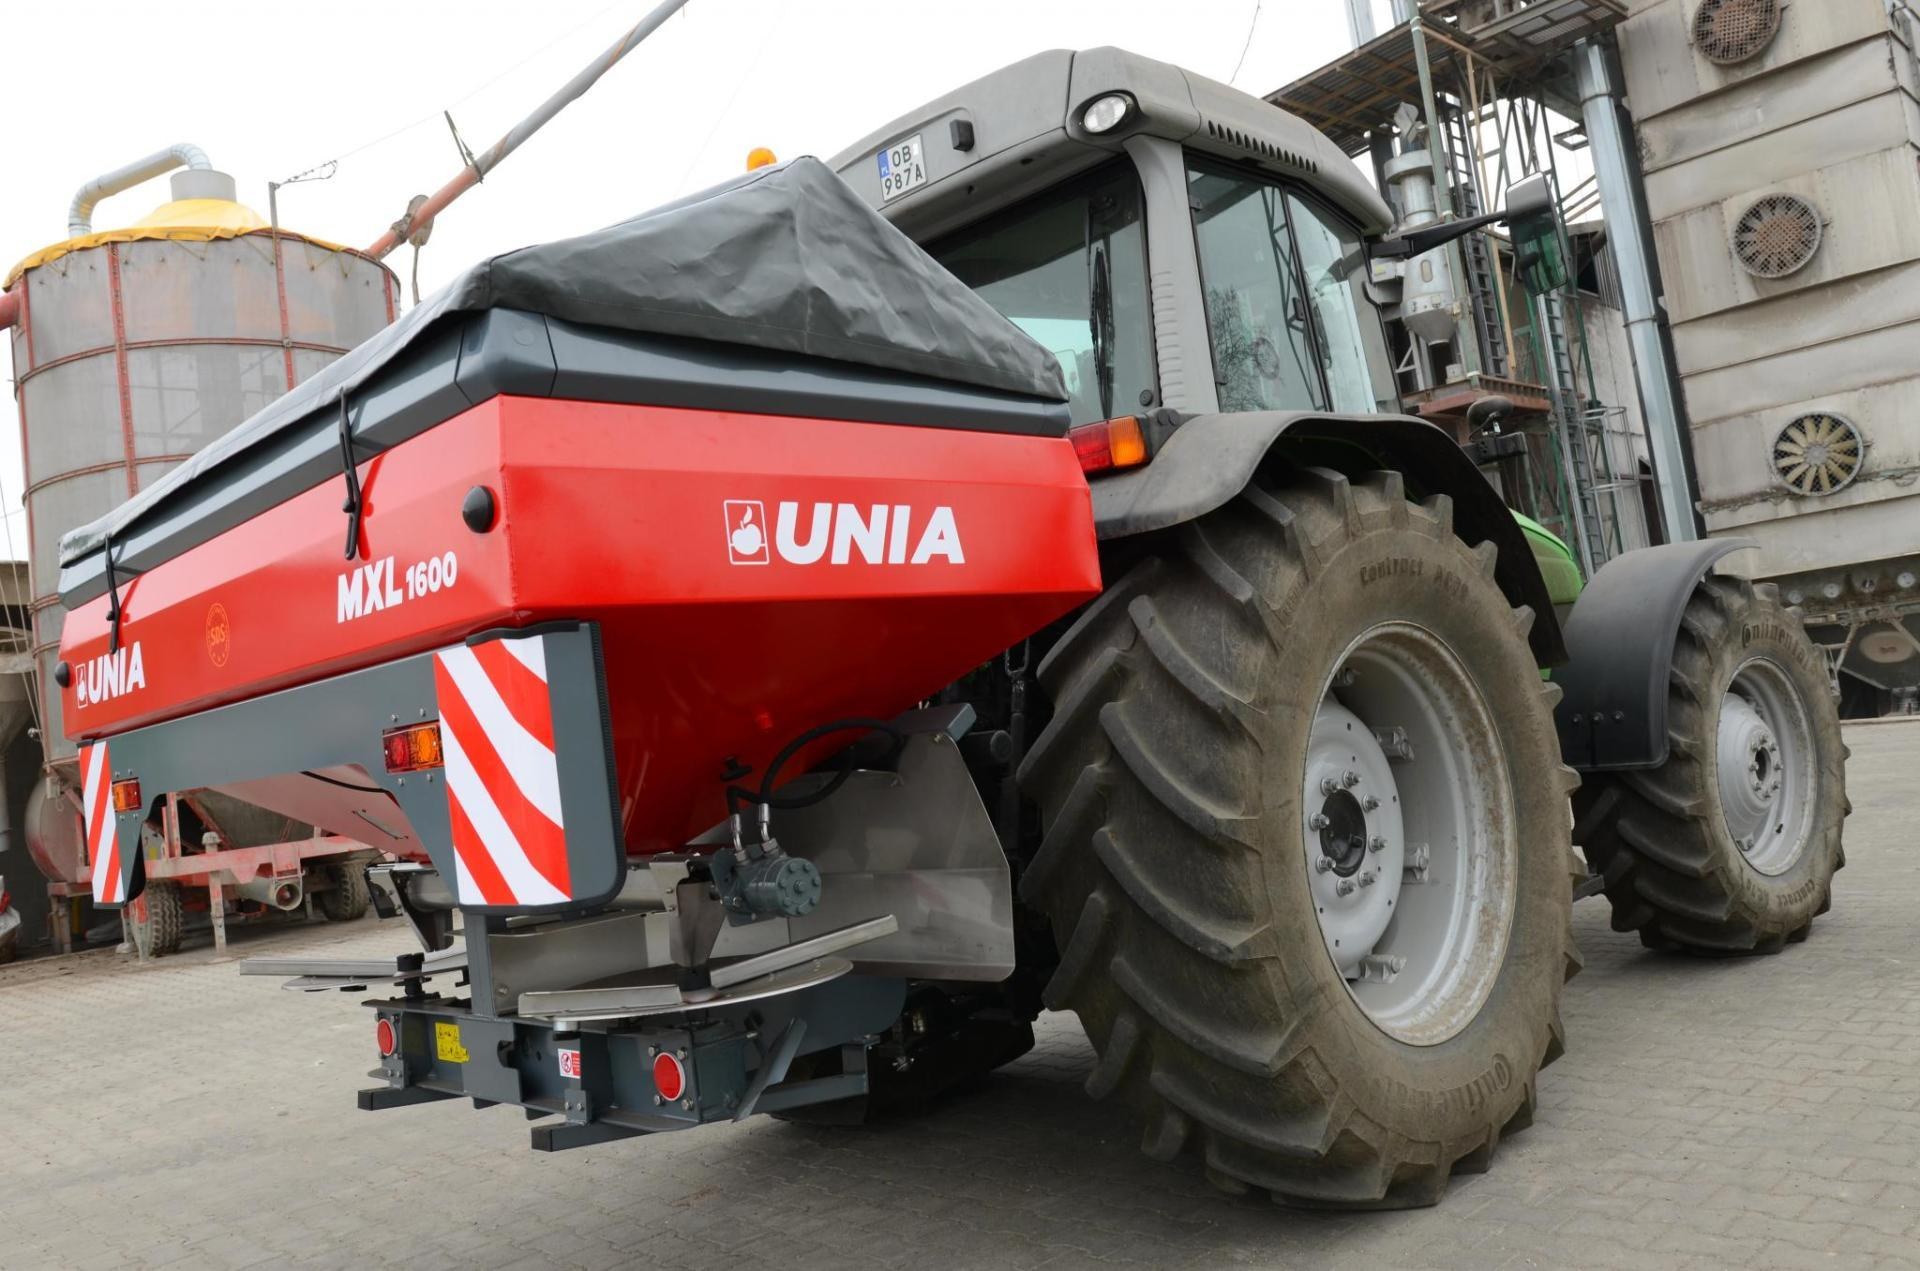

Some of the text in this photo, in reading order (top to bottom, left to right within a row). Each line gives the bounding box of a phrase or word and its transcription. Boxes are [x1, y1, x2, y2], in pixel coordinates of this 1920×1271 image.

[884, 163, 923, 195] 987A
[892, 145, 912, 168] OB
[775, 500, 966, 565] UNIA
[337, 551, 458, 624] MXL 1600
[87, 640, 146, 704] UNIA
[1368, 1053, 1513, 1114] Contine
